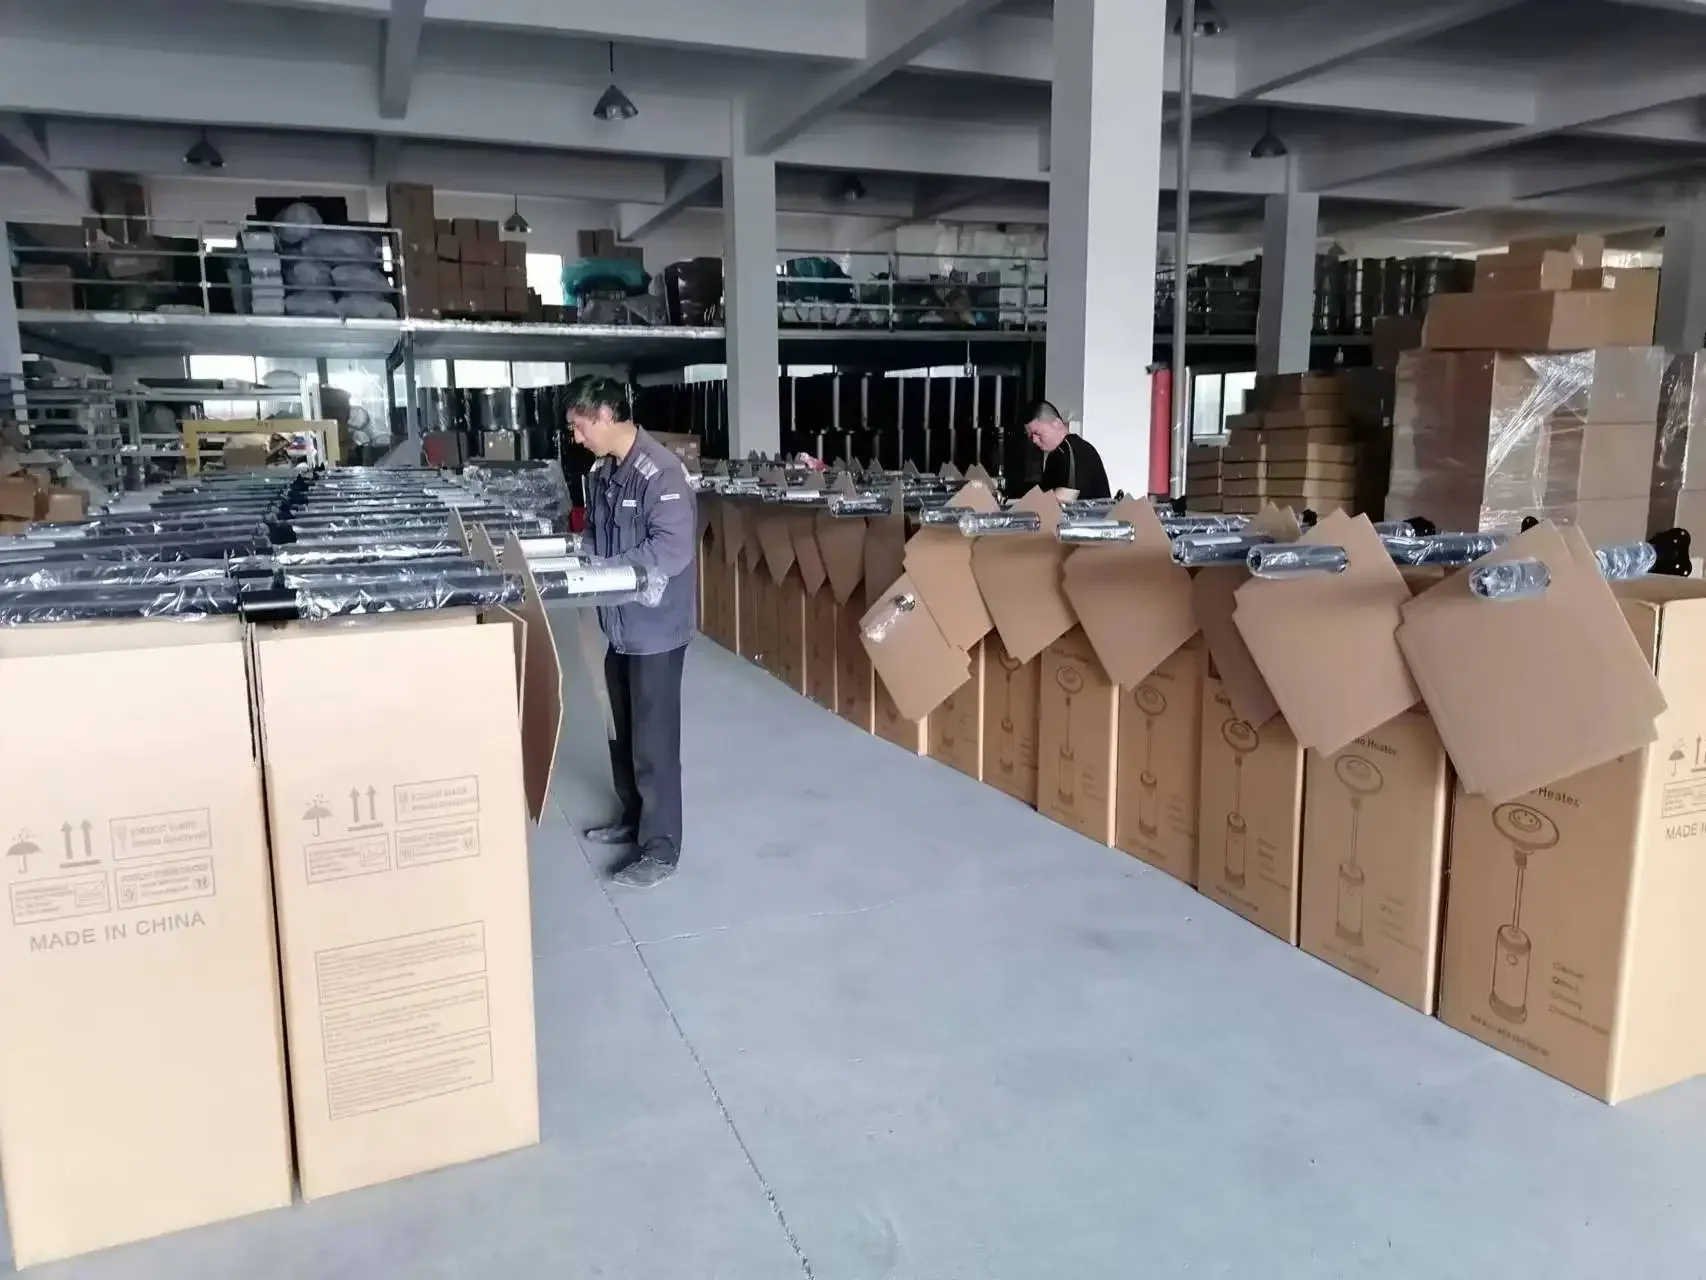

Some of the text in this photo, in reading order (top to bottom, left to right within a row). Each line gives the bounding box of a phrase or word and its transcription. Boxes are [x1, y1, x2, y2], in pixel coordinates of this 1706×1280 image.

[1538, 786, 1580, 808] Heater
[1665, 822, 1698, 840] MADE
[30, 911, 206, 952] MADE IN CHINA
